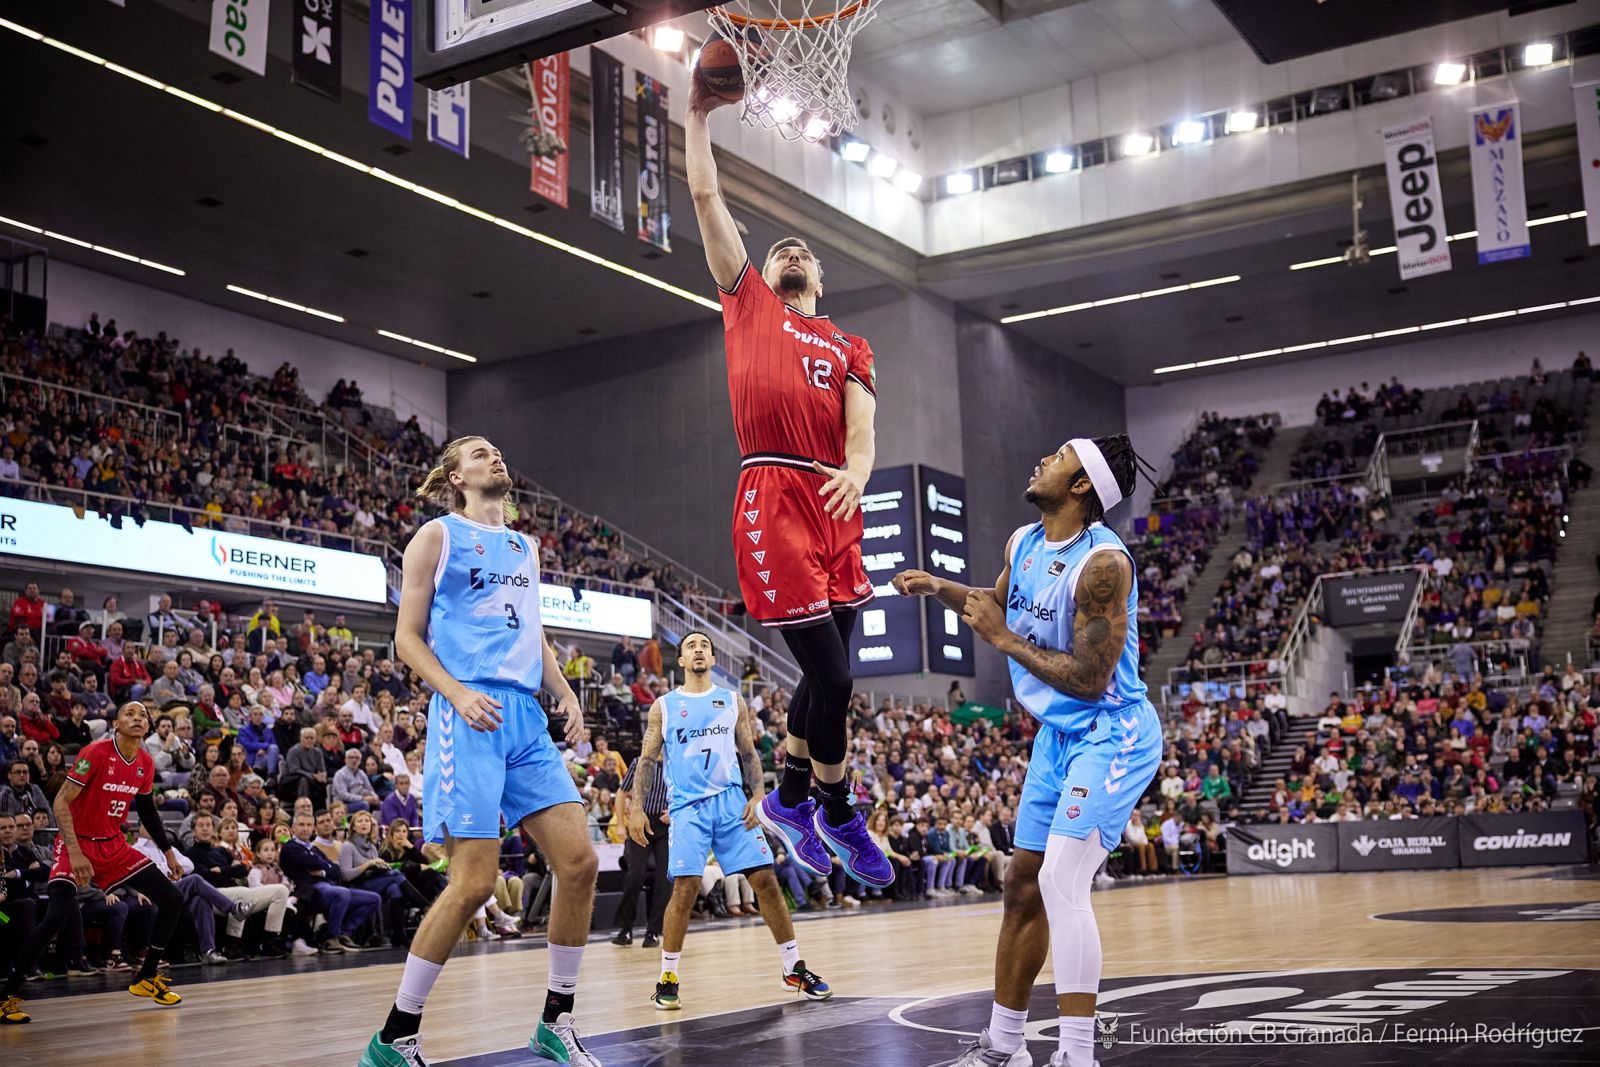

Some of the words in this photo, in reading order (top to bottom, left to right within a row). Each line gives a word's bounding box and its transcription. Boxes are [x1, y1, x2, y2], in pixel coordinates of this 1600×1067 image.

[376, 0, 405, 124] PULE
[1398, 143, 1437, 253] Jeep
[801, 356, 833, 390] 12
[231, 548, 316, 574] BERNER
[230, 568, 269, 580] PUSHING
[271, 574, 287, 582] THE
[289, 577, 317, 587] LIMITS
[488, 572, 529, 588] zunde
[504, 603, 520, 630] 3
[539, 596, 591, 614] ERNER
[1020, 595, 1057, 622] zuder
[689, 724, 730, 739] zunder
[701, 748, 712, 770] 7
[107, 799, 127, 818] 32
[1247, 838, 1316, 867] alight
[1406, 835, 1446, 847] RURAL
